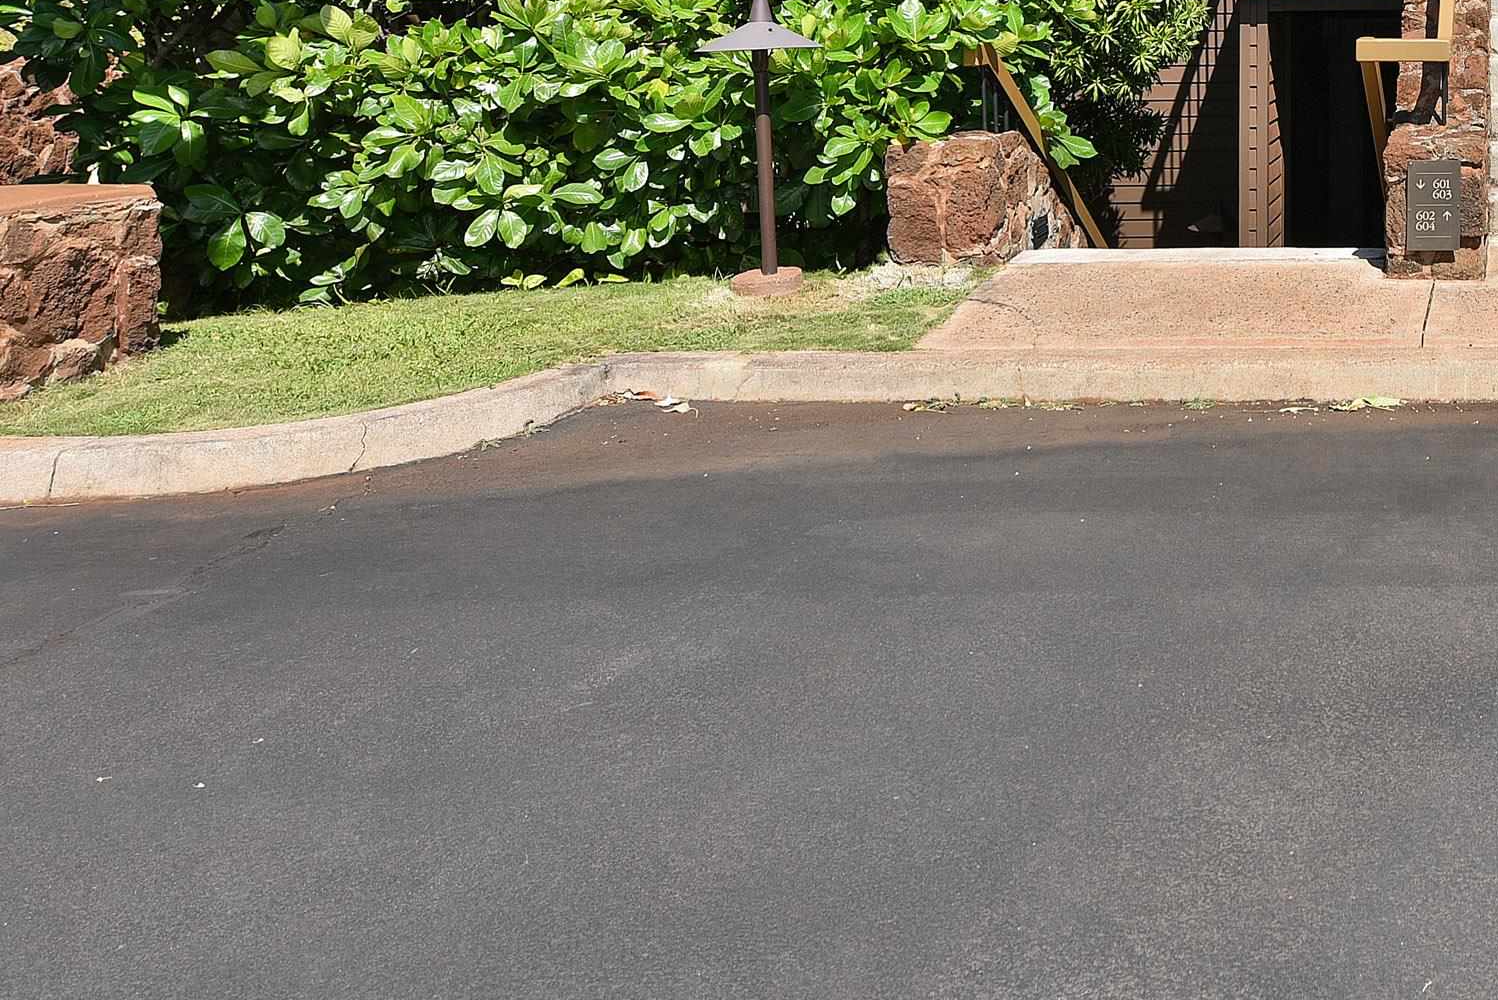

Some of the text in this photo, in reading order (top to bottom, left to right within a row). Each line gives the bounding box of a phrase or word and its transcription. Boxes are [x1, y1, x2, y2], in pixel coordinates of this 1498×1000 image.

[1432, 178, 1450, 189] 601
[1432, 189, 1452, 200] 603
[1415, 210, 1435, 221] 602
[1415, 220, 1435, 231] 604
